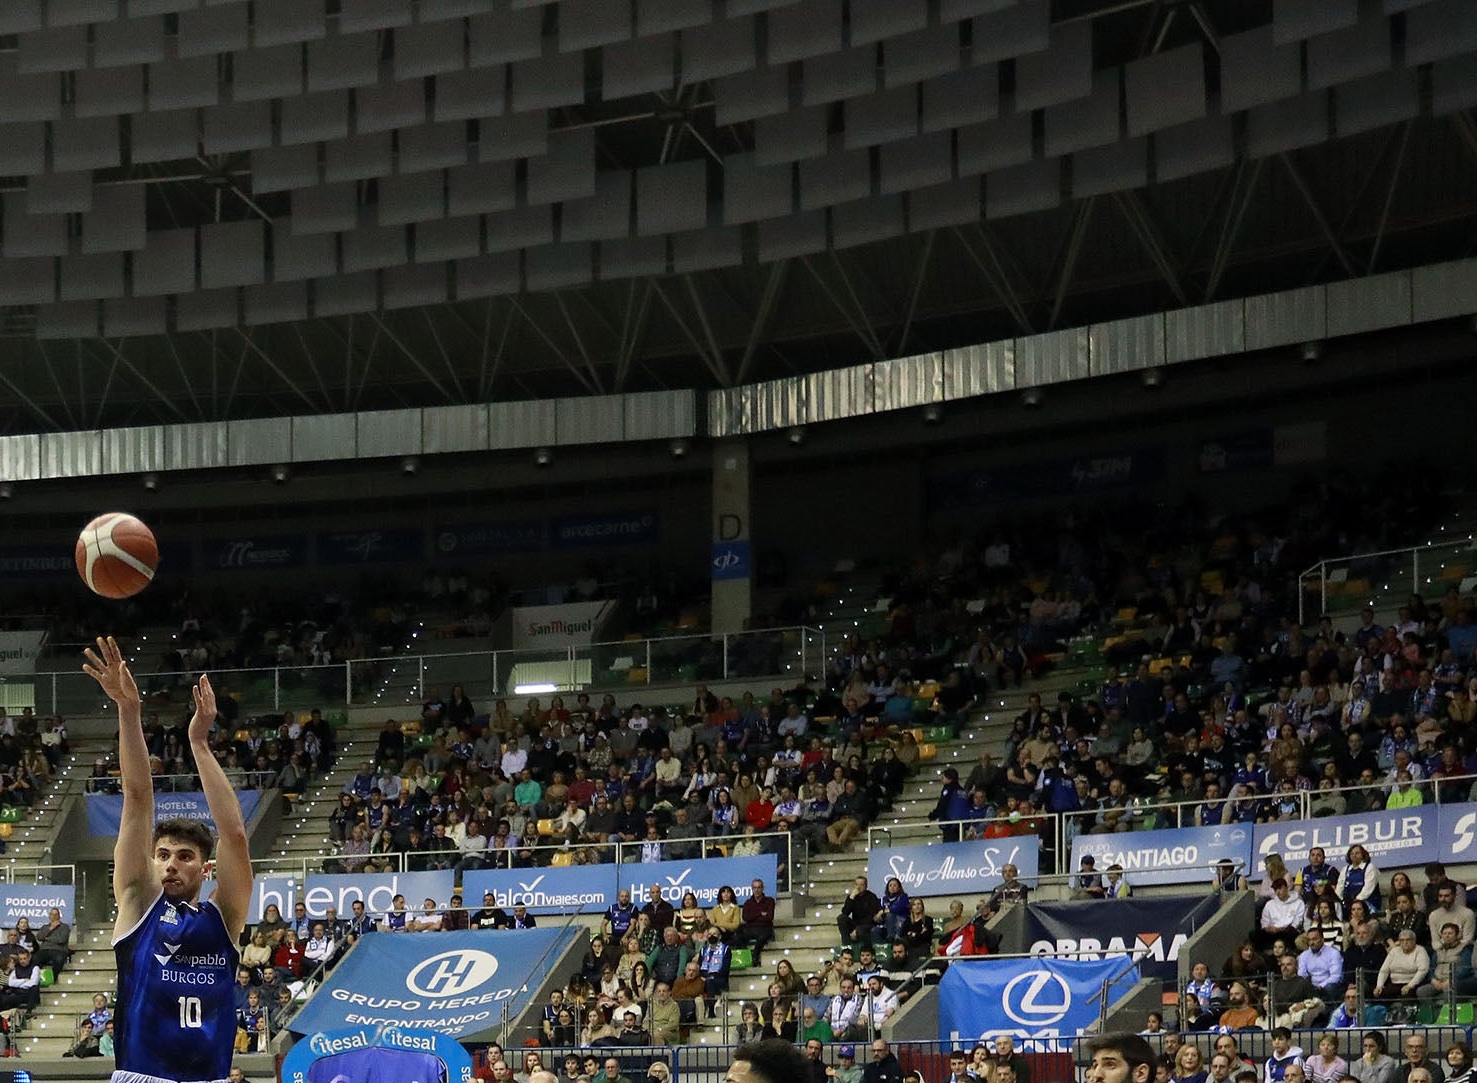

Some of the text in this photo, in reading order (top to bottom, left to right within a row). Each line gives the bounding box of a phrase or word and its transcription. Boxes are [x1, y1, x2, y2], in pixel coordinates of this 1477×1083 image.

[718, 513, 742, 541] D
[157, 801, 197, 811] HOTELES
[1285, 816, 1423, 850] CLIBUR
[926, 855, 977, 881] Alonso
[5, 896, 67, 909] PODOLOGÍA
[1030, 932, 1192, 963] OBRAMA
[161, 969, 215, 985] BURGOS
[178, 996, 202, 1029] 10
[331, 987, 421, 1012] GRUPO
